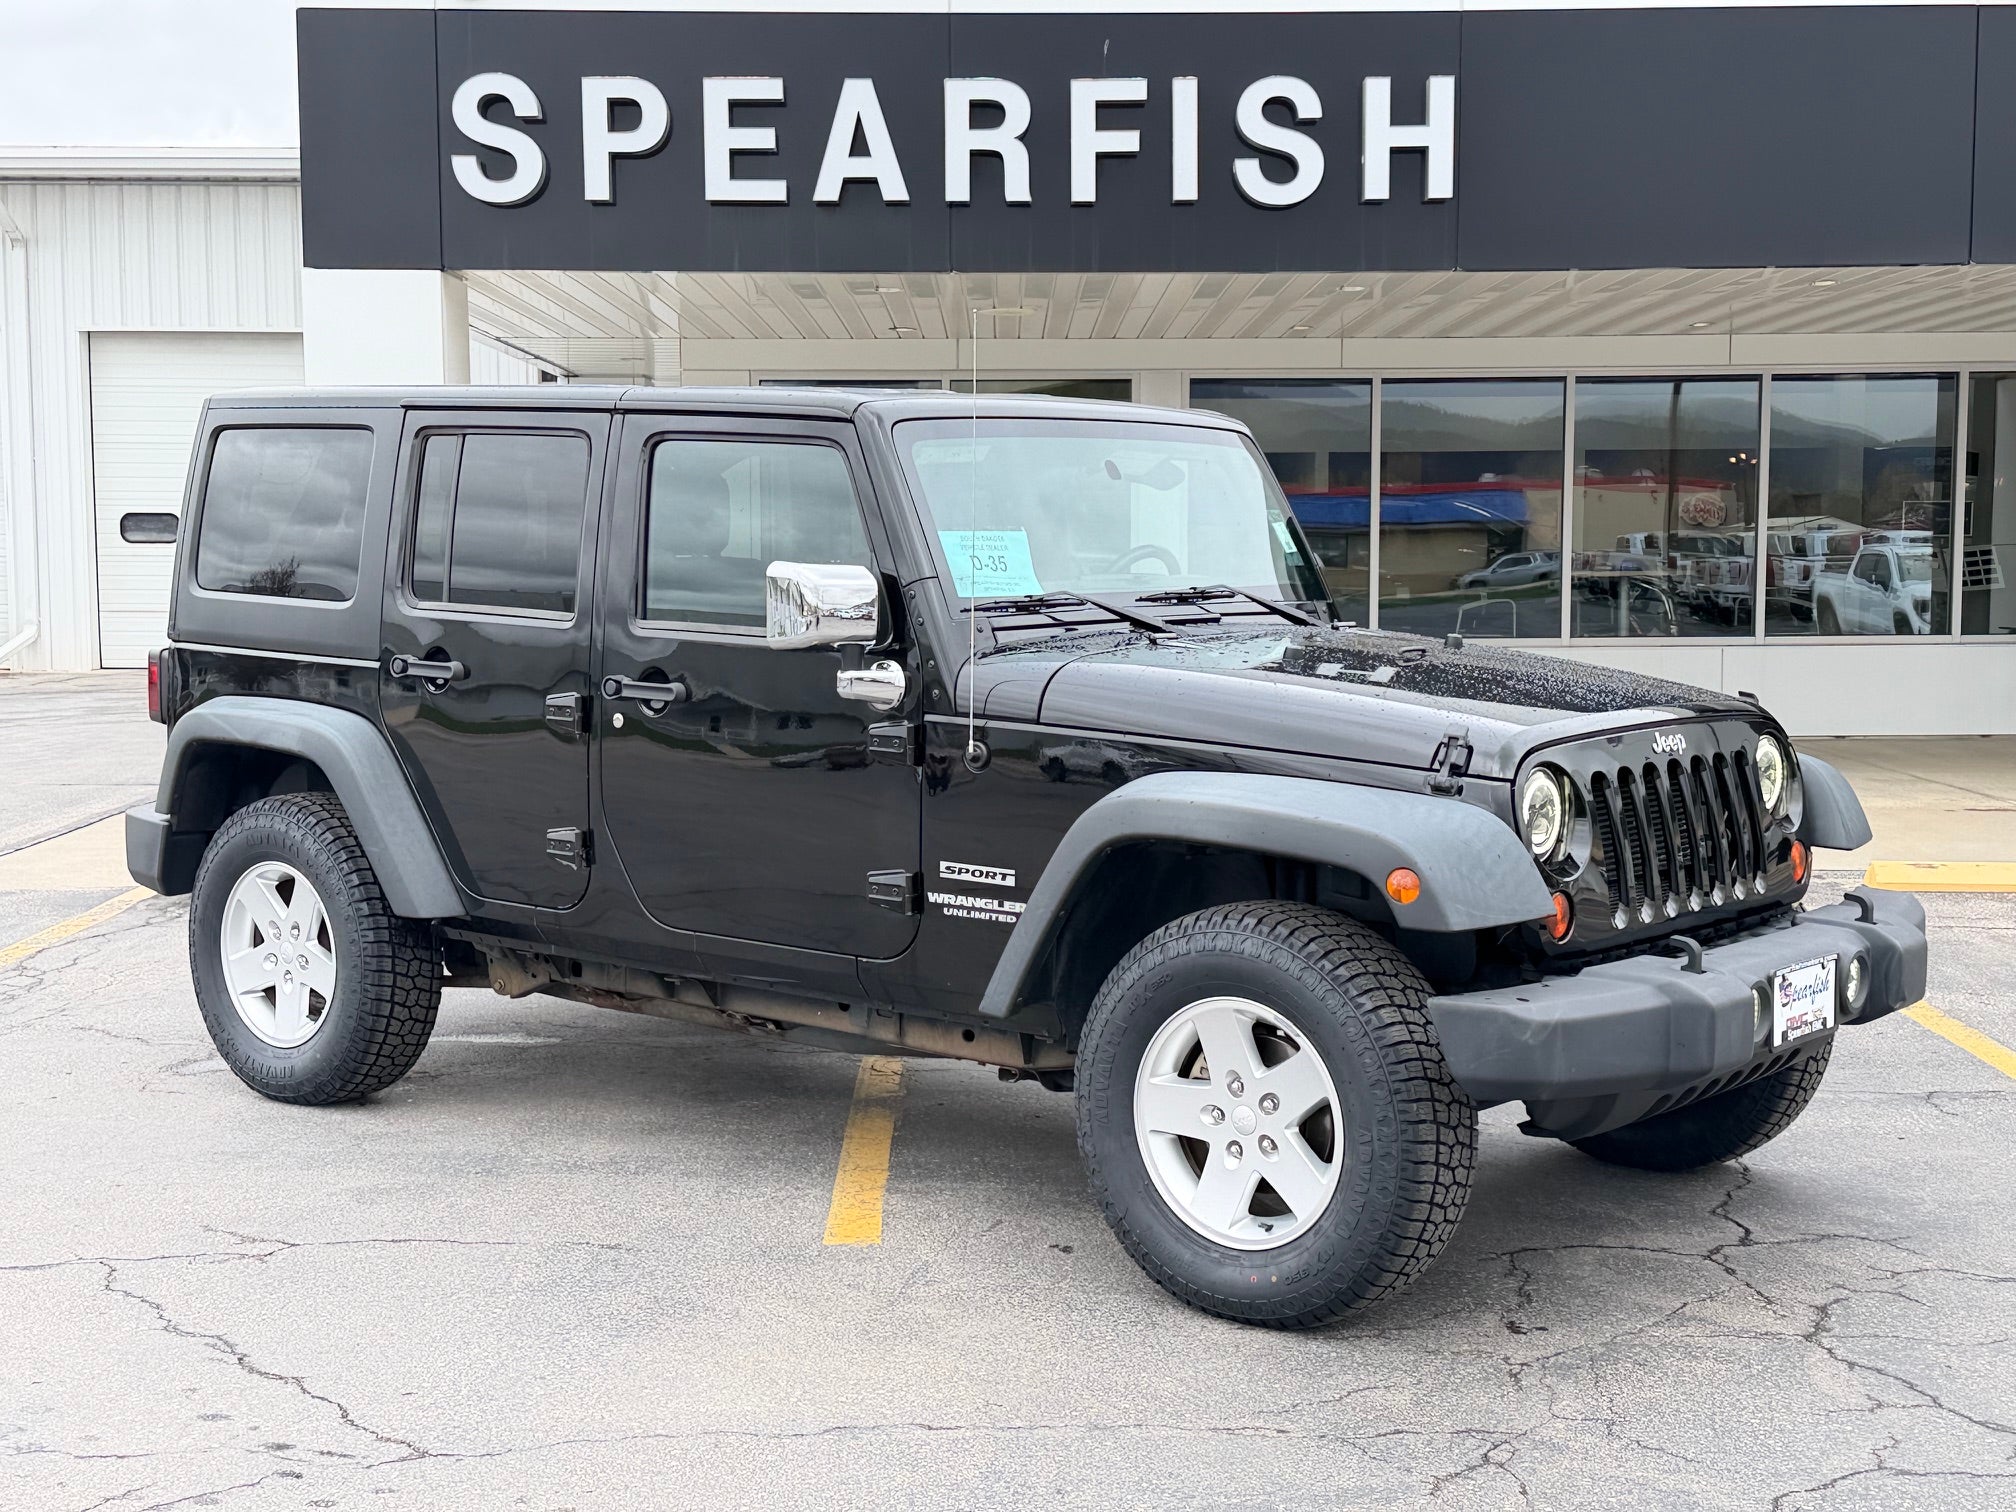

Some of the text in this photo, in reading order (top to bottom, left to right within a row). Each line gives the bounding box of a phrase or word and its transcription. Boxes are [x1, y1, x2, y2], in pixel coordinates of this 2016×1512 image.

[450, 71, 1456, 208] SPEARFISH
[1652, 731, 1687, 755] Jeep
[940, 864, 1015, 882] SPORT
[927, 892, 1027, 914] WRANGLER
[943, 907, 1017, 923] UNLIMITED
[1780, 967, 1831, 1011] Spearfish
